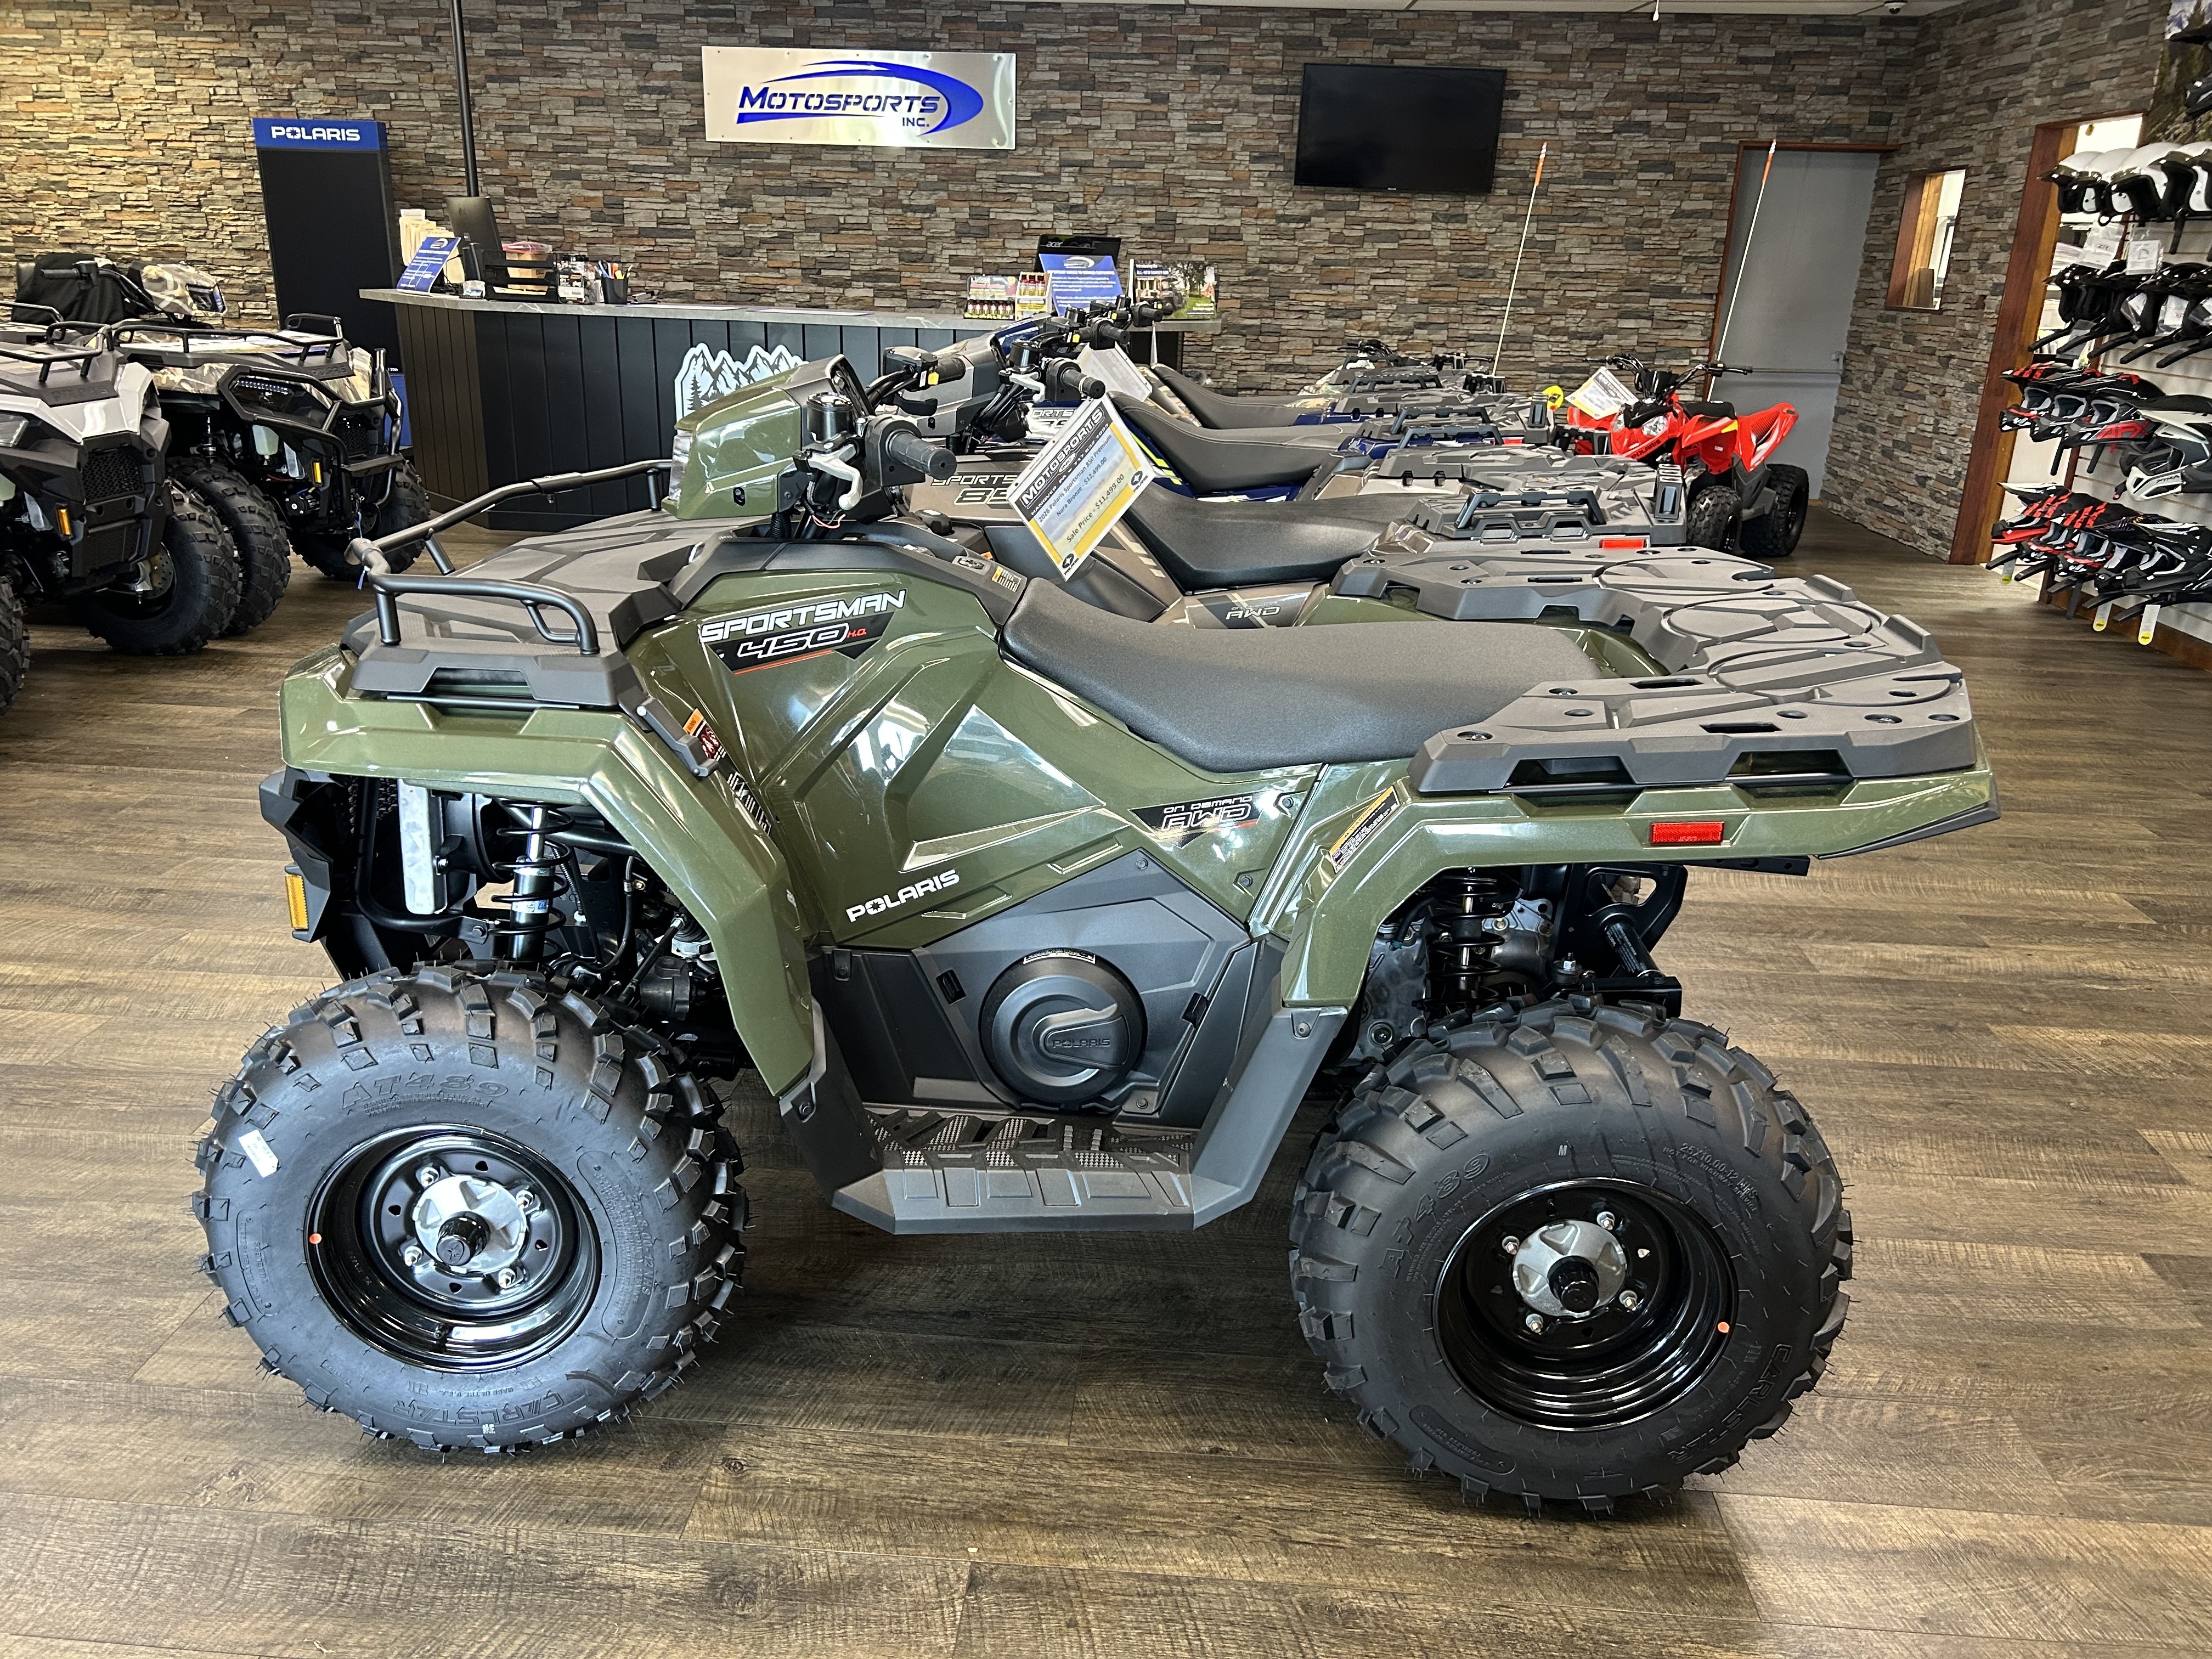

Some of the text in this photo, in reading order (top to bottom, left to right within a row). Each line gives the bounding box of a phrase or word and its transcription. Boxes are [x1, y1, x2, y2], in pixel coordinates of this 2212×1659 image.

[738, 86, 941, 114] MOTOSPORTS
[272, 126, 360, 142] POLARIS
[902, 117, 929, 127] INC.
[1023, 408, 1104, 505] MOTOSPORTS
[1631, 438, 1662, 459] POLARIS
[1038, 509, 1050, 523] 2026
[1049, 492, 1064, 510] Polaris
[1063, 465, 1087, 493] Sportsman
[1085, 456, 1094, 467] 850
[1093, 435, 1113, 458] Premium
[1056, 504, 1068, 517] Nara
[1067, 486, 1082, 505] Bronze
[1084, 456, 1108, 486] $12,499.00
[1066, 527, 1079, 543] Sale
[1078, 512, 1093, 530] Price
[1095, 473, 1125, 510] $11,499.00
[700, 589, 906, 643] SPORTSMAN
[1226, 606, 1280, 620] AWD
[737, 623, 850, 658] 450
[1161, 803, 1252, 832] AWD
[1164, 795, 1252, 814] ON DEMAND
[846, 869, 960, 922] POLARIS
[1052, 1038, 1111, 1048] POLARIS
